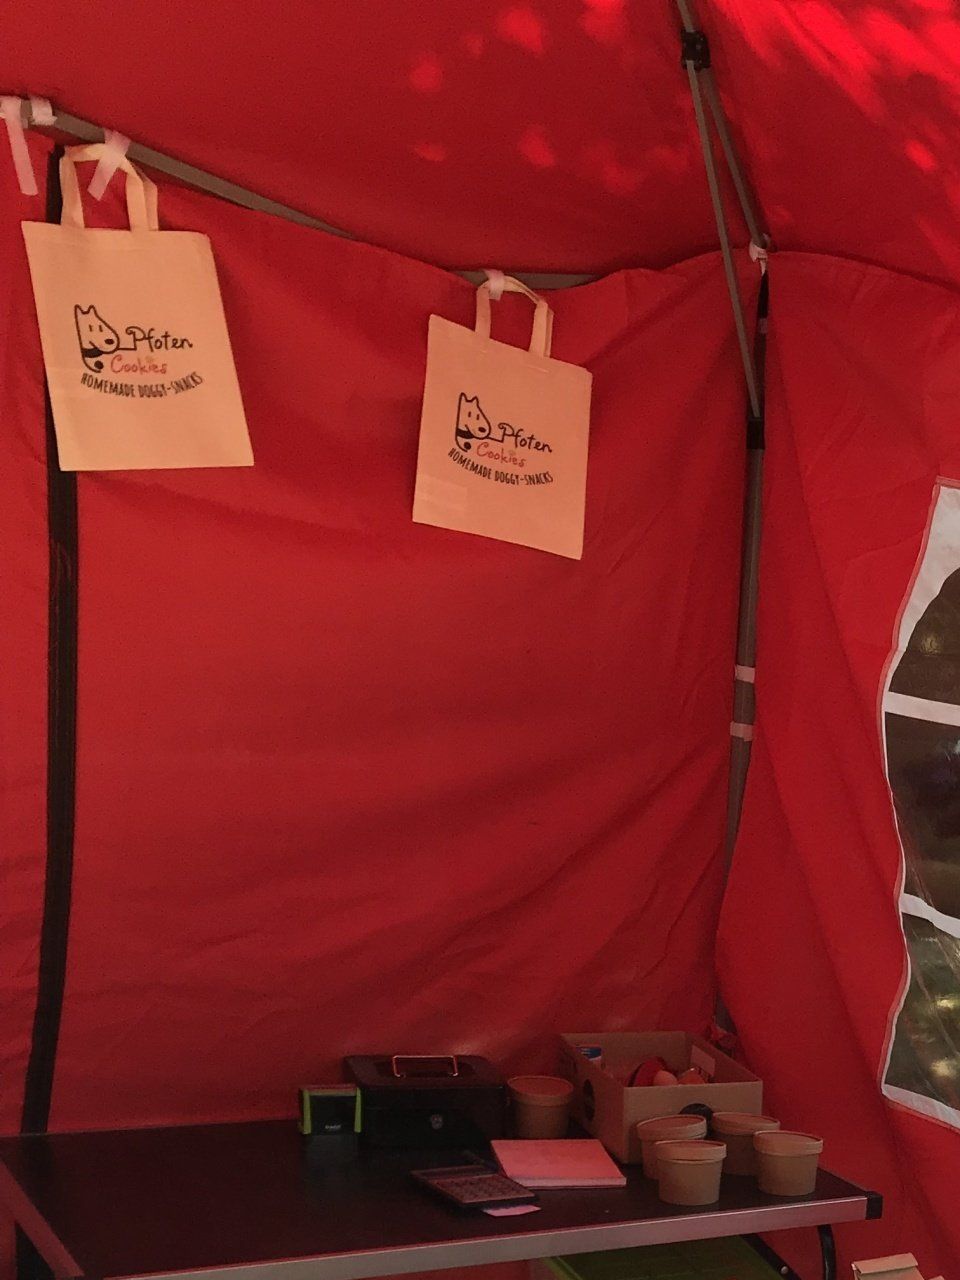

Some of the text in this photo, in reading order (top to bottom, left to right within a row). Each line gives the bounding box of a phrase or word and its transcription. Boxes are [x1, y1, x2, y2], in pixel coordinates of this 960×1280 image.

[125, 326, 193, 352] Pfoten
[110, 354, 168, 374] Cookies
[81, 372, 136, 398] HOMEMADE
[497, 422, 553, 453] Pfoten
[448, 447, 492, 480] HOMEMADE
[476, 441, 527, 468] Cookies
